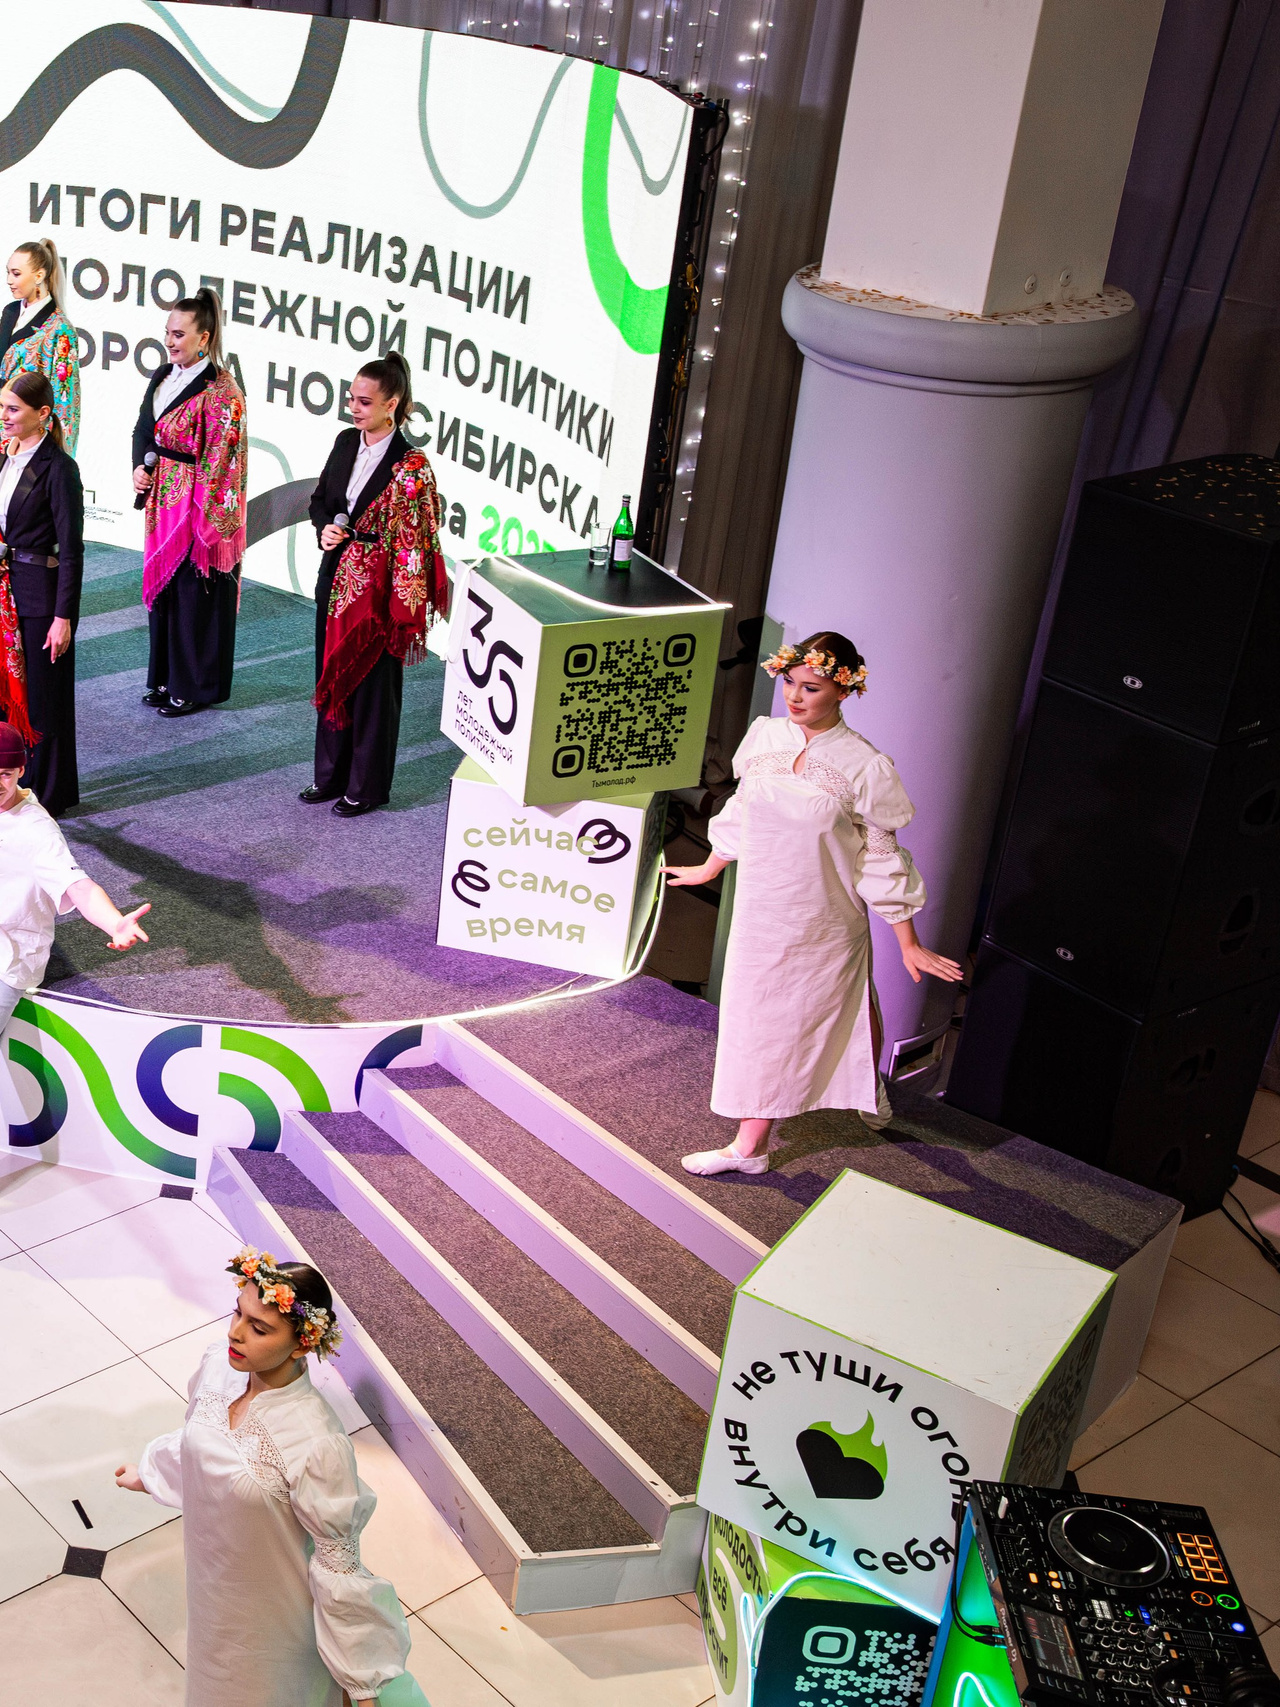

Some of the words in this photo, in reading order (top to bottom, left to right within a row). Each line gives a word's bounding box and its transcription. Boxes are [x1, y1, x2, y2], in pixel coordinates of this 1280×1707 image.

[29, 182, 201, 242] ИТОГИ
[219, 203, 531, 325] РЕАЛИЗАЦИИ
[58, 257, 407, 359] ОЛОЕЖНОЙ
[422, 325, 615, 468] ПОЛИТИКИ
[266, 361, 599, 540] НОСИБИРСКА
[457, 690, 473, 710] лет
[454, 718, 496, 764] политике
[455, 703, 513, 766] молодежной
[462, 818, 599, 857] сейчас
[496, 863, 616, 914] самое
[466, 917, 586, 944] время
[731, 1360, 776, 1400] не
[779, 1350, 904, 1404] туши
[724, 1417, 837, 1558] внутри
[853, 1537, 956, 1575] себя
